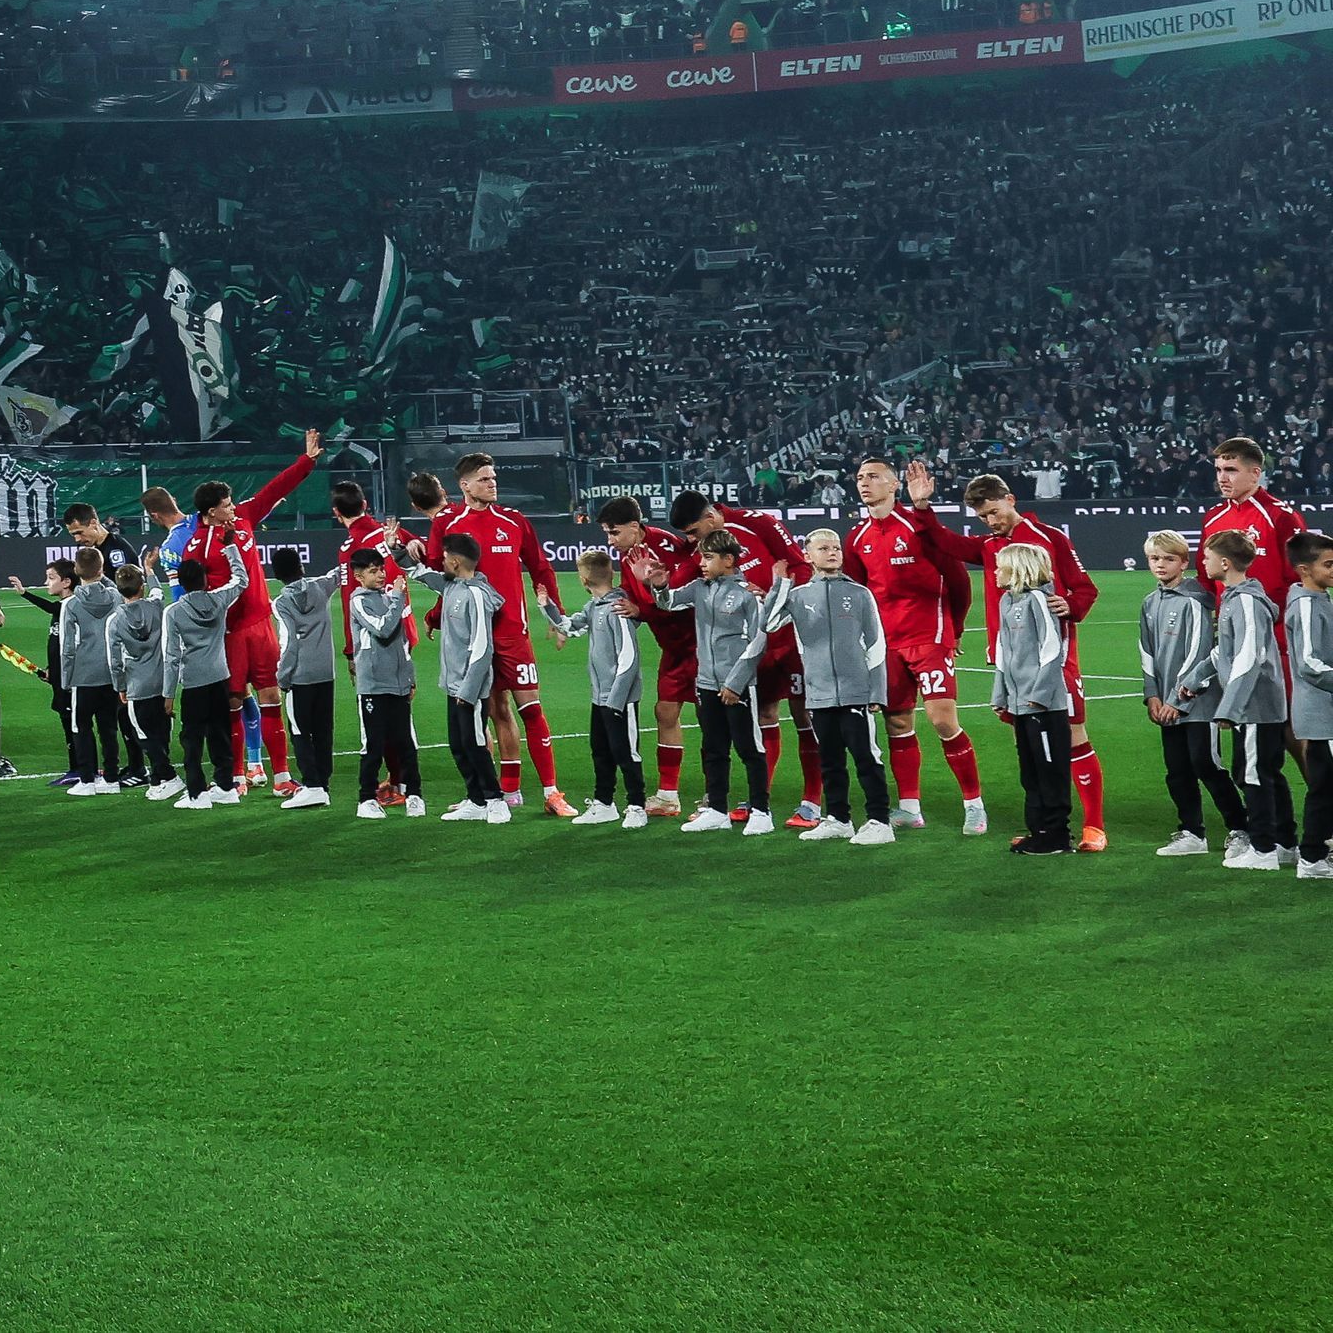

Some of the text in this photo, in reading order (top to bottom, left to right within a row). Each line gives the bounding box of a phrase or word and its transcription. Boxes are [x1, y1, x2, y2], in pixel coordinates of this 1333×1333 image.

[1257, 1, 1283, 21] RP
[1086, 7, 1236, 46] RHEINISCHE POST
[976, 36, 1065, 60] ELTEN
[780, 54, 862, 78] ELTEN
[565, 74, 638, 95] cewe
[666, 66, 736, 89] cewe
[580, 484, 662, 498] NORDHARZ
[491, 545, 513, 553] REWE
[738, 558, 762, 572] REWE
[890, 556, 915, 565] REWE
[340, 562, 349, 586] DEVK
[516, 663, 538, 685] 30
[790, 673, 804, 695] 3
[920, 670, 946, 695] 32
